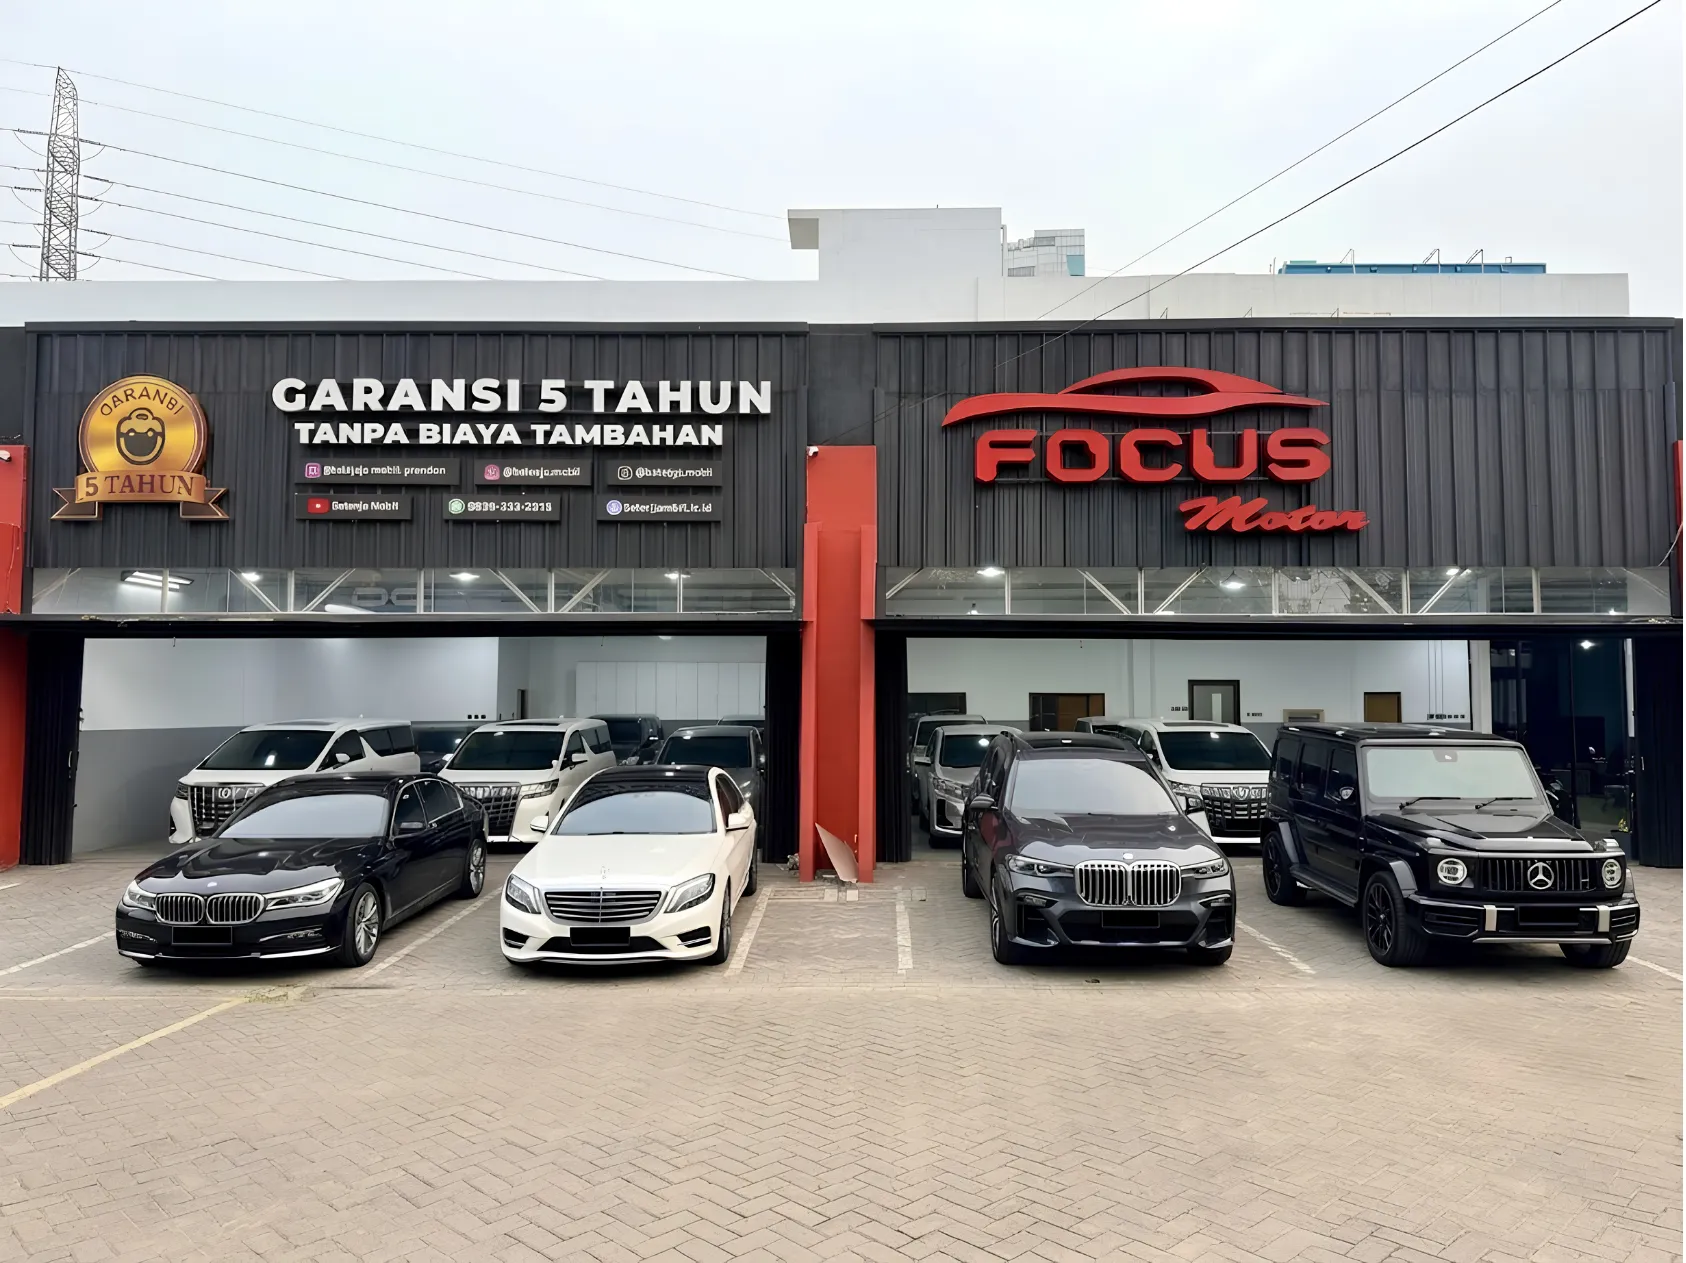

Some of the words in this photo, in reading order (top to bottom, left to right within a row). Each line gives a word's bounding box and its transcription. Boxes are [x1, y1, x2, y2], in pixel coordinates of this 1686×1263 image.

[271, 377, 520, 413] GARANSI
[538, 378, 568, 413] 5
[583, 379, 772, 414] TAHUN
[294, 422, 410, 444] TANPA
[419, 423, 522, 445] BIAYA
[530, 424, 724, 447] TAMBAHAN
[974, 427, 1332, 485] FOCUS
[86, 476, 99, 497] 5
[104, 474, 194, 497] TAHUN
[1178, 495, 1370, 533] Motor
